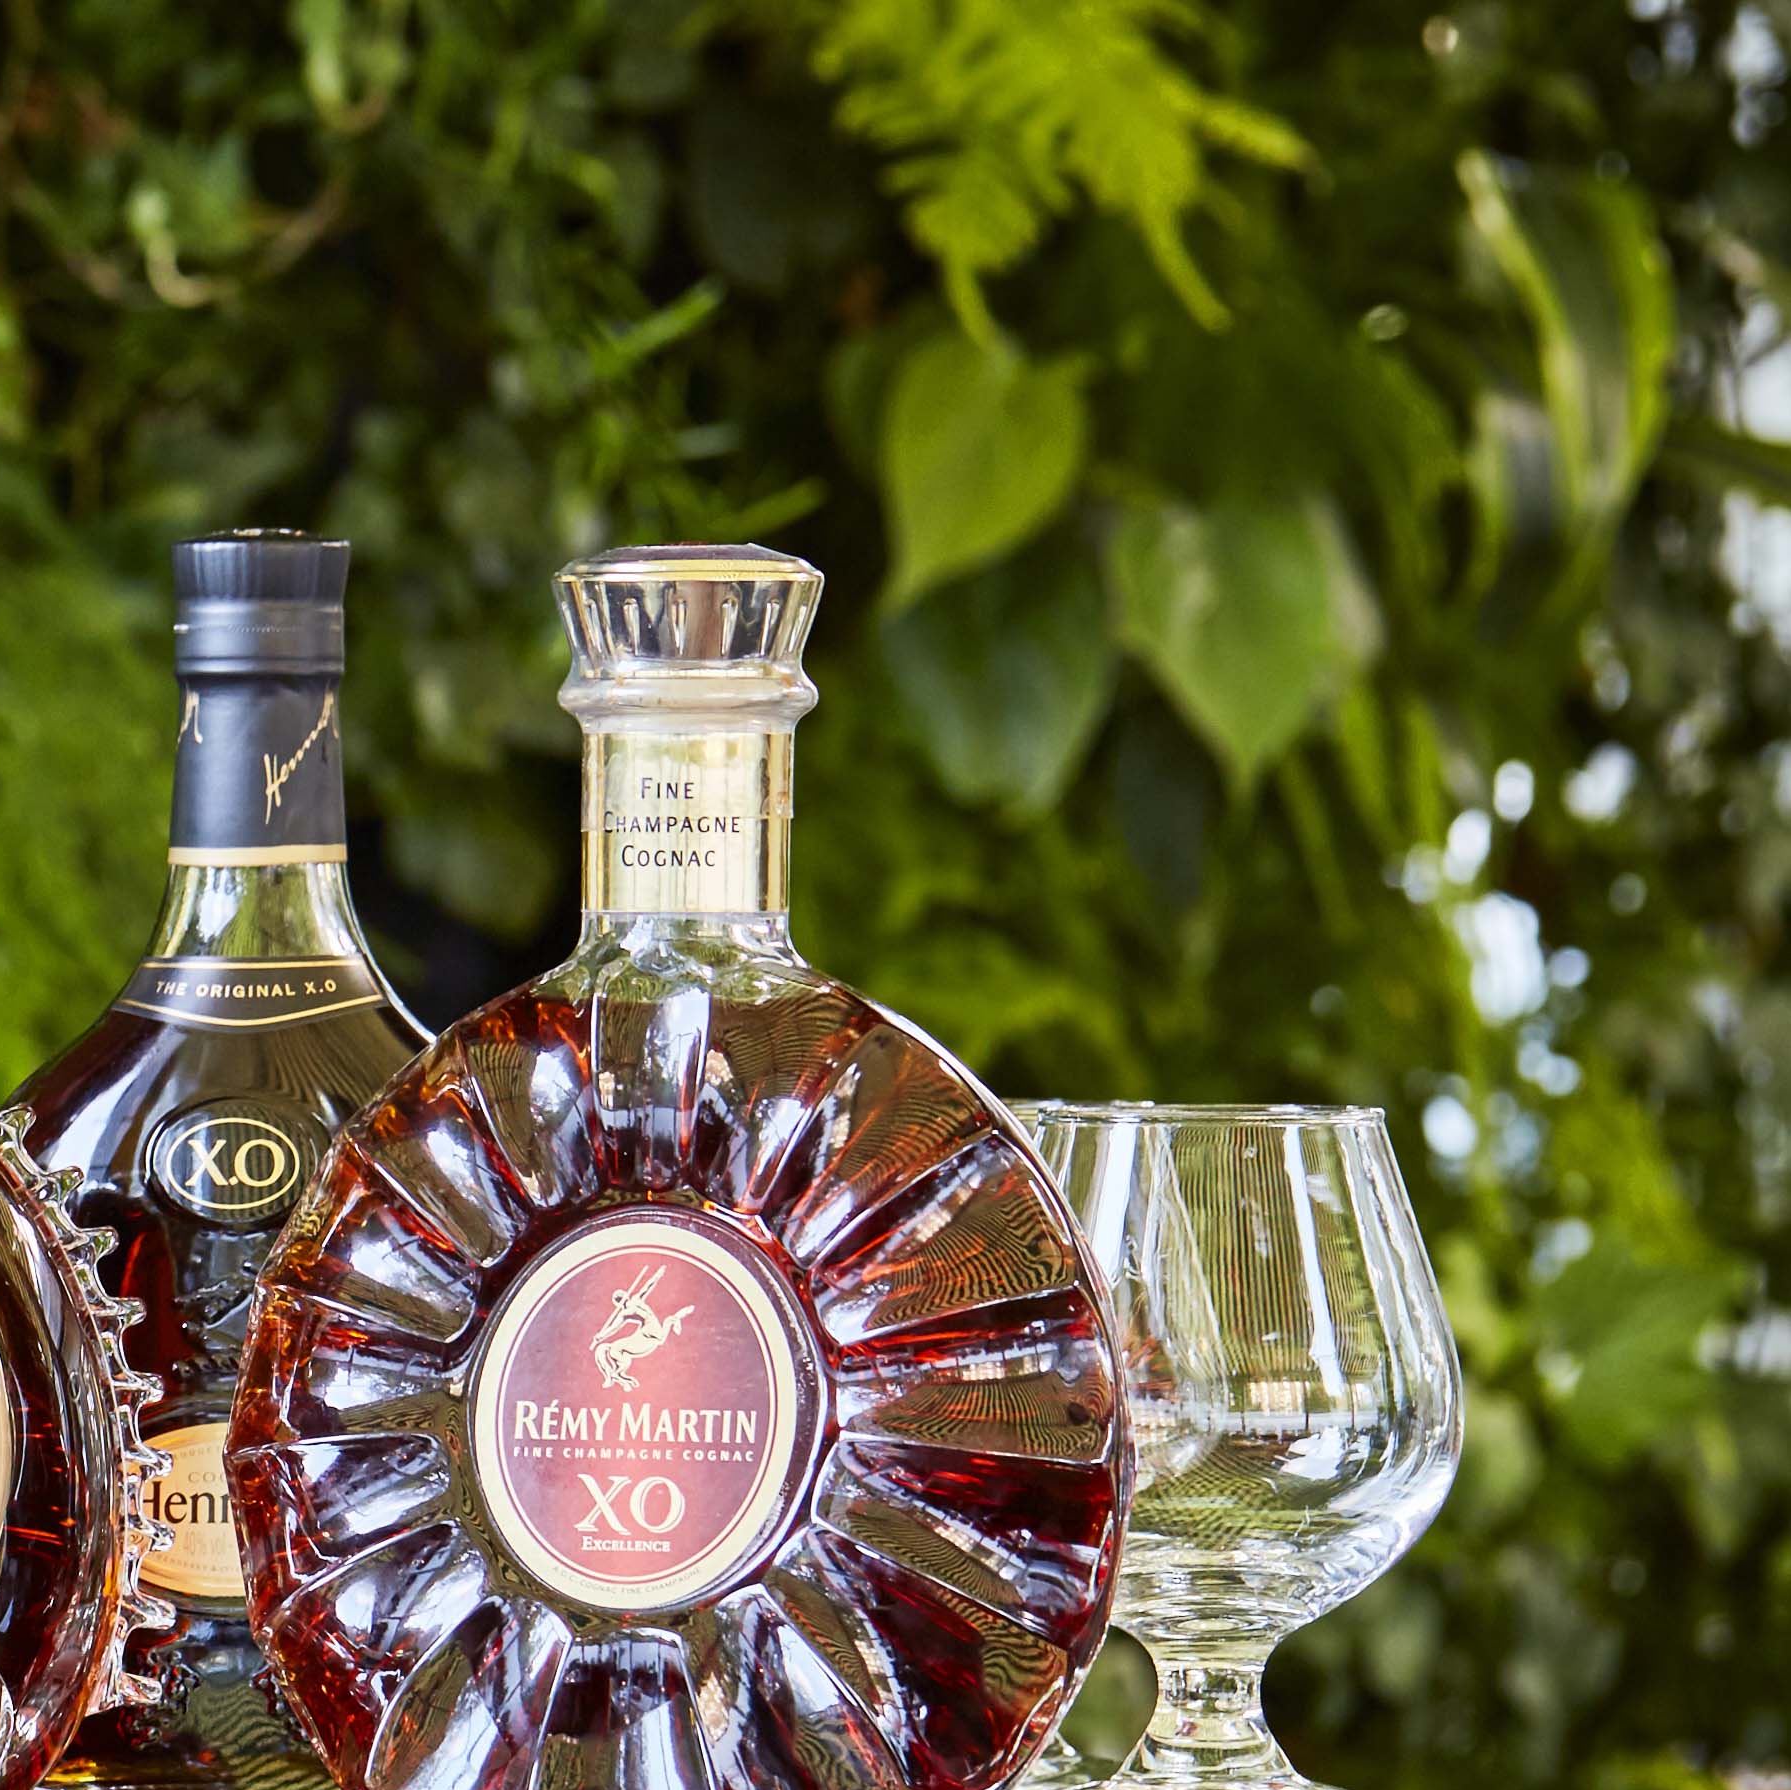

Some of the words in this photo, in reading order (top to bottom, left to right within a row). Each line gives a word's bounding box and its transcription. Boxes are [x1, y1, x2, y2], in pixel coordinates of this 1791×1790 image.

[641, 777, 694, 800] FINE
[603, 811, 740, 834] CHAMPAGNE
[621, 844, 716, 868] COGNAC
[156, 981, 187, 996] THE
[196, 983, 296, 998] ORIGINAL
[514, 1399, 611, 1442] RÉMY
[619, 1401, 757, 1444] MARTIN
[513, 1447, 553, 1459] FINE
[563, 1447, 673, 1461] CHAMPAGNE
[683, 1449, 755, 1462] COGNAC
[574, 1473, 686, 1536] XO
[581, 1536, 671, 1552] EXCELLENCE
